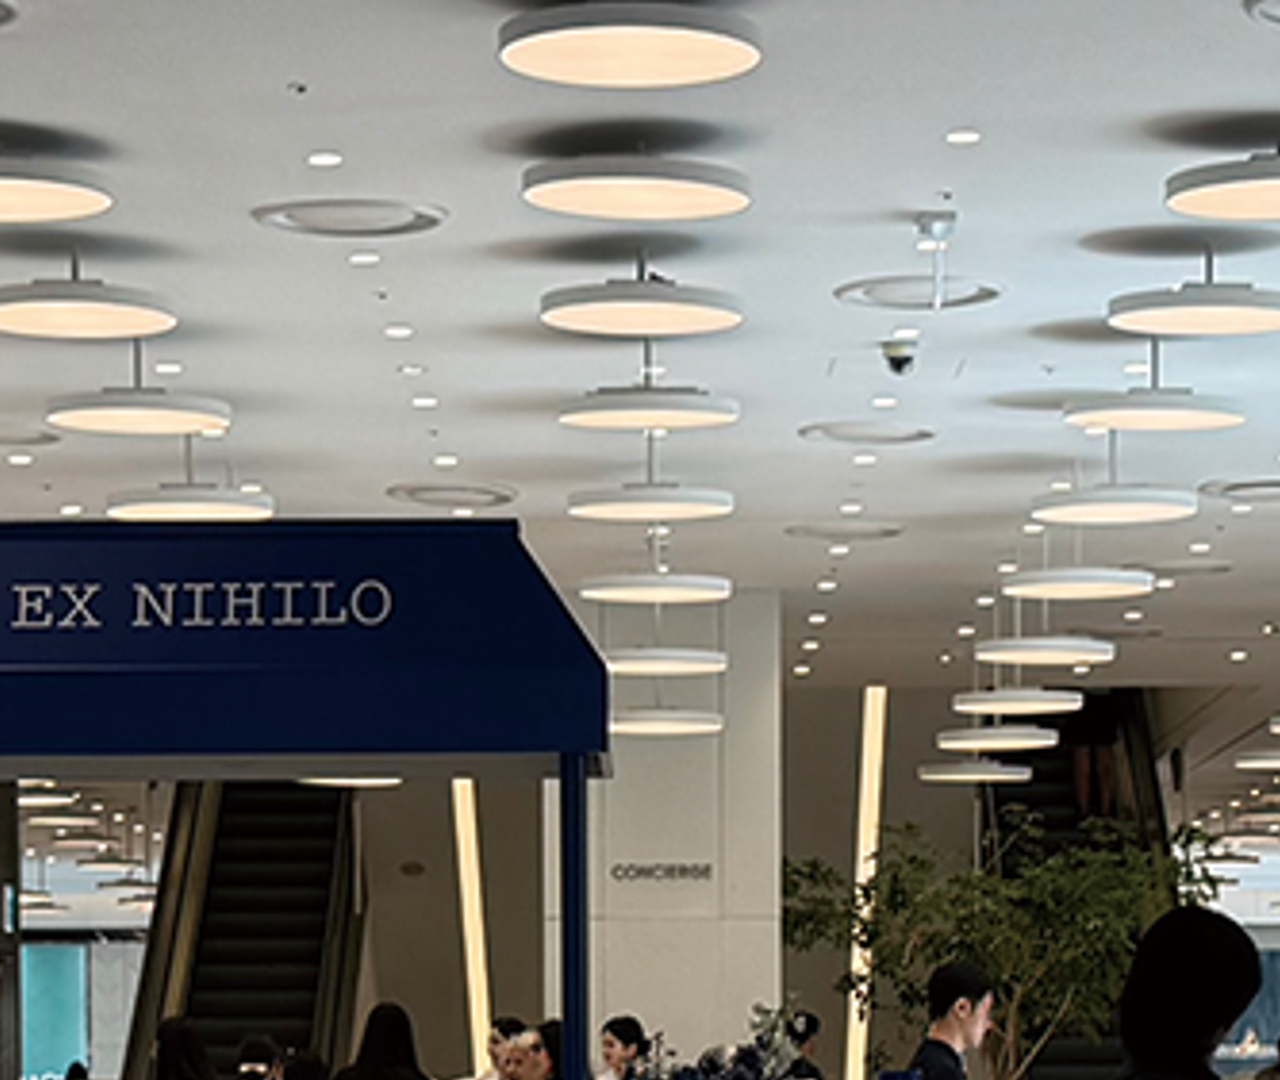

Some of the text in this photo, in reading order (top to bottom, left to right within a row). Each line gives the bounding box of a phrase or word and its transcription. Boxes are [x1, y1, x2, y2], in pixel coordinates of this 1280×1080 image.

[10, 579, 393, 628] EX NIHILO
[610, 863, 712, 882] CONCIERGE
